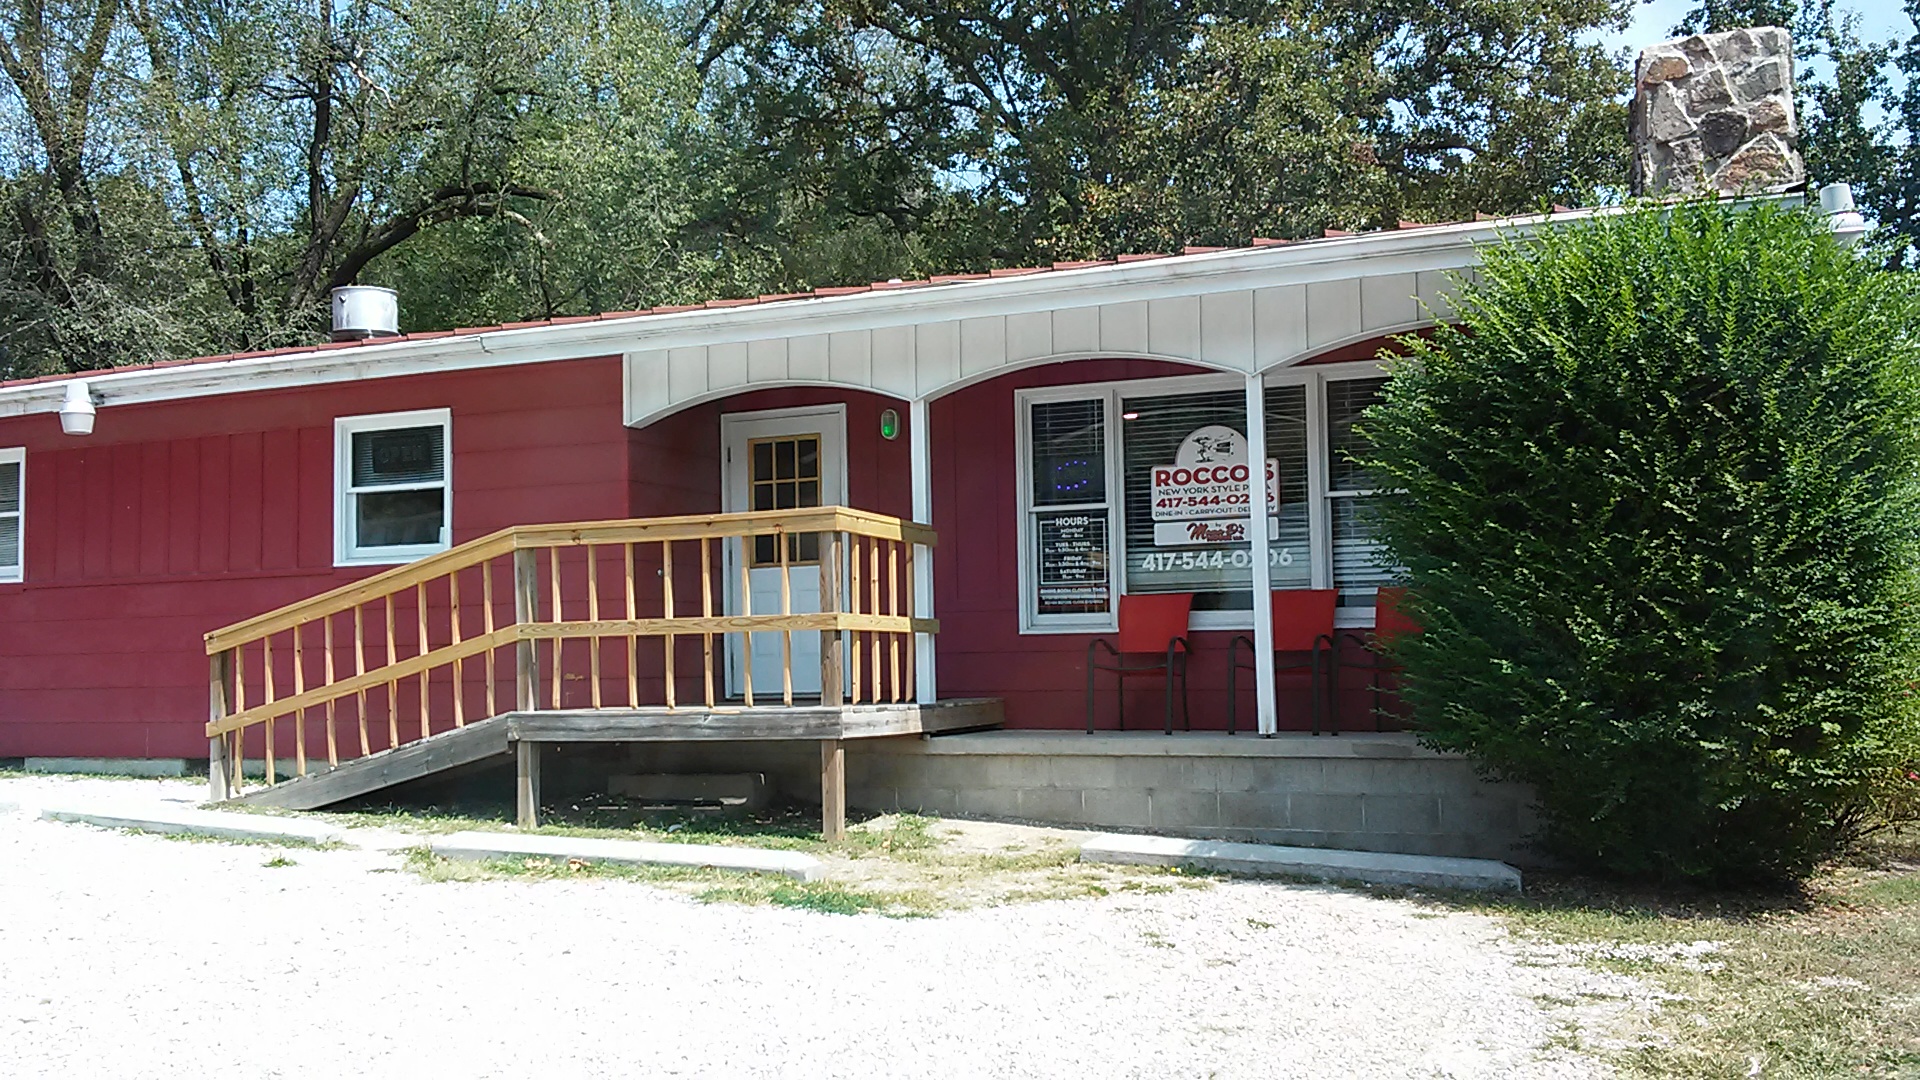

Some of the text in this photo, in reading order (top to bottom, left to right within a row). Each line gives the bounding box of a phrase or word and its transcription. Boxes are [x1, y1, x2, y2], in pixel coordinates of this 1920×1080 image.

[1155, 463, 1275, 487] ROCCOS
[1158, 487, 1181, 496] NEW
[1183, 486, 1209, 495] YORK
[1211, 484, 1240, 493] STYLE
[1156, 492, 1275, 508] 417-544-026
[1155, 508, 1183, 517] DINE-IN
[1055, 516, 1089, 526] HOURS
